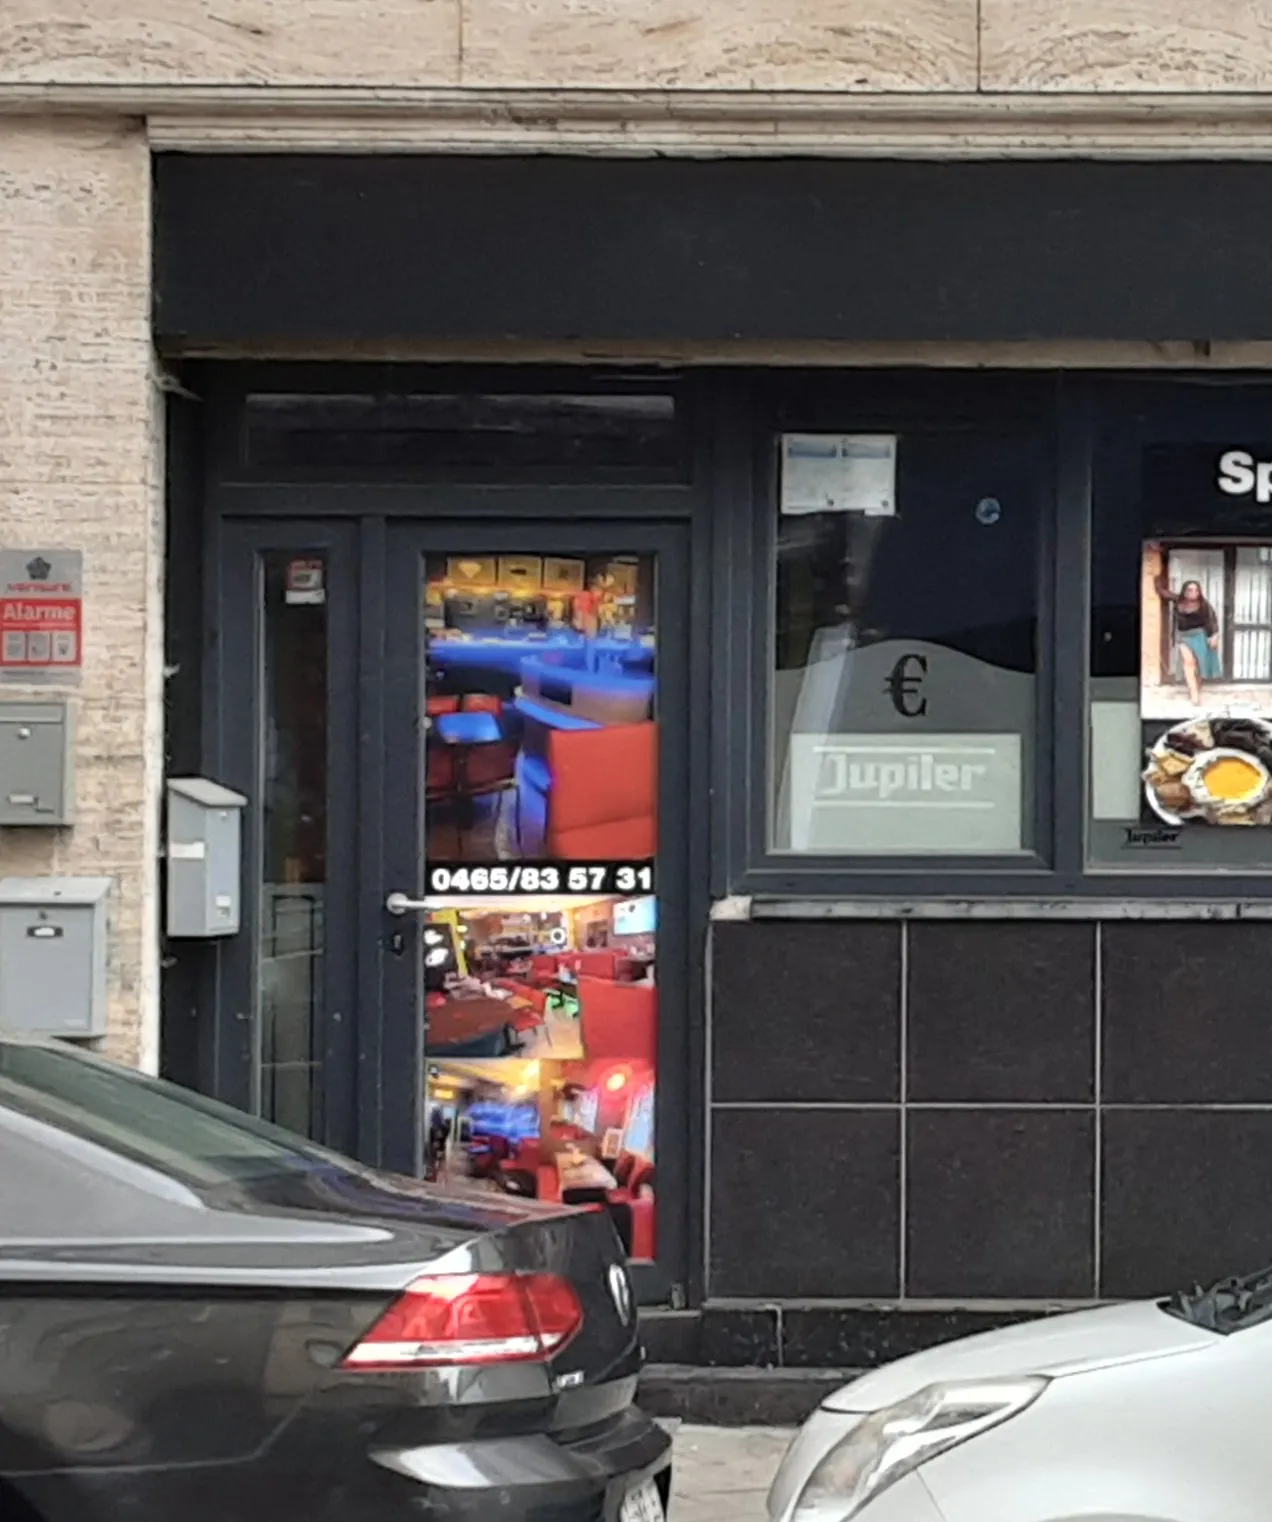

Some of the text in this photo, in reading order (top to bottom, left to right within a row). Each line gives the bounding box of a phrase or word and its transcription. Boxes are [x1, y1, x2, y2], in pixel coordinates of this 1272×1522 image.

[4, 602, 76, 621] Alarme
[815, 753, 986, 799] Jupiler
[431, 867, 651, 891] 0465/83 57 31
